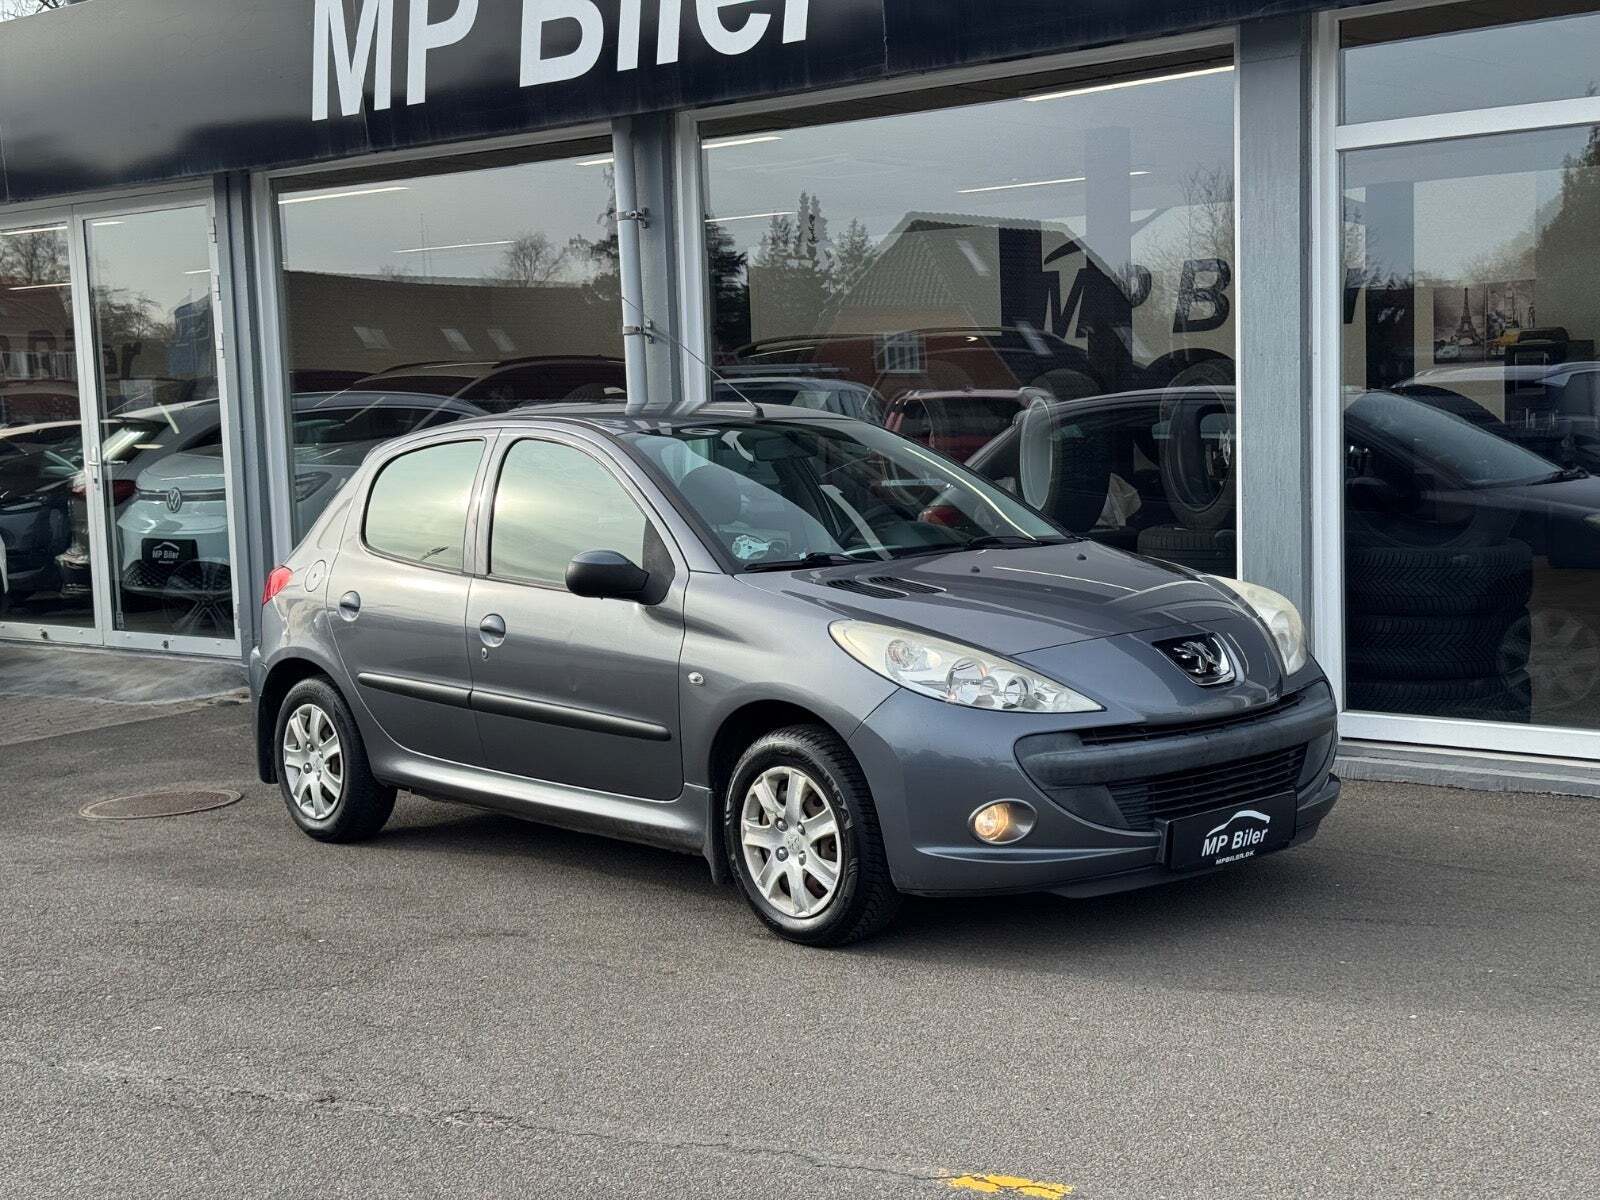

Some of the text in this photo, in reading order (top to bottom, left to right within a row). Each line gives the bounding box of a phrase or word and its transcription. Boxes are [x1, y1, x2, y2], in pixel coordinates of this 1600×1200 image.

[311, 0, 478, 121] MP
[1201, 828, 1269, 857] MP Biler
